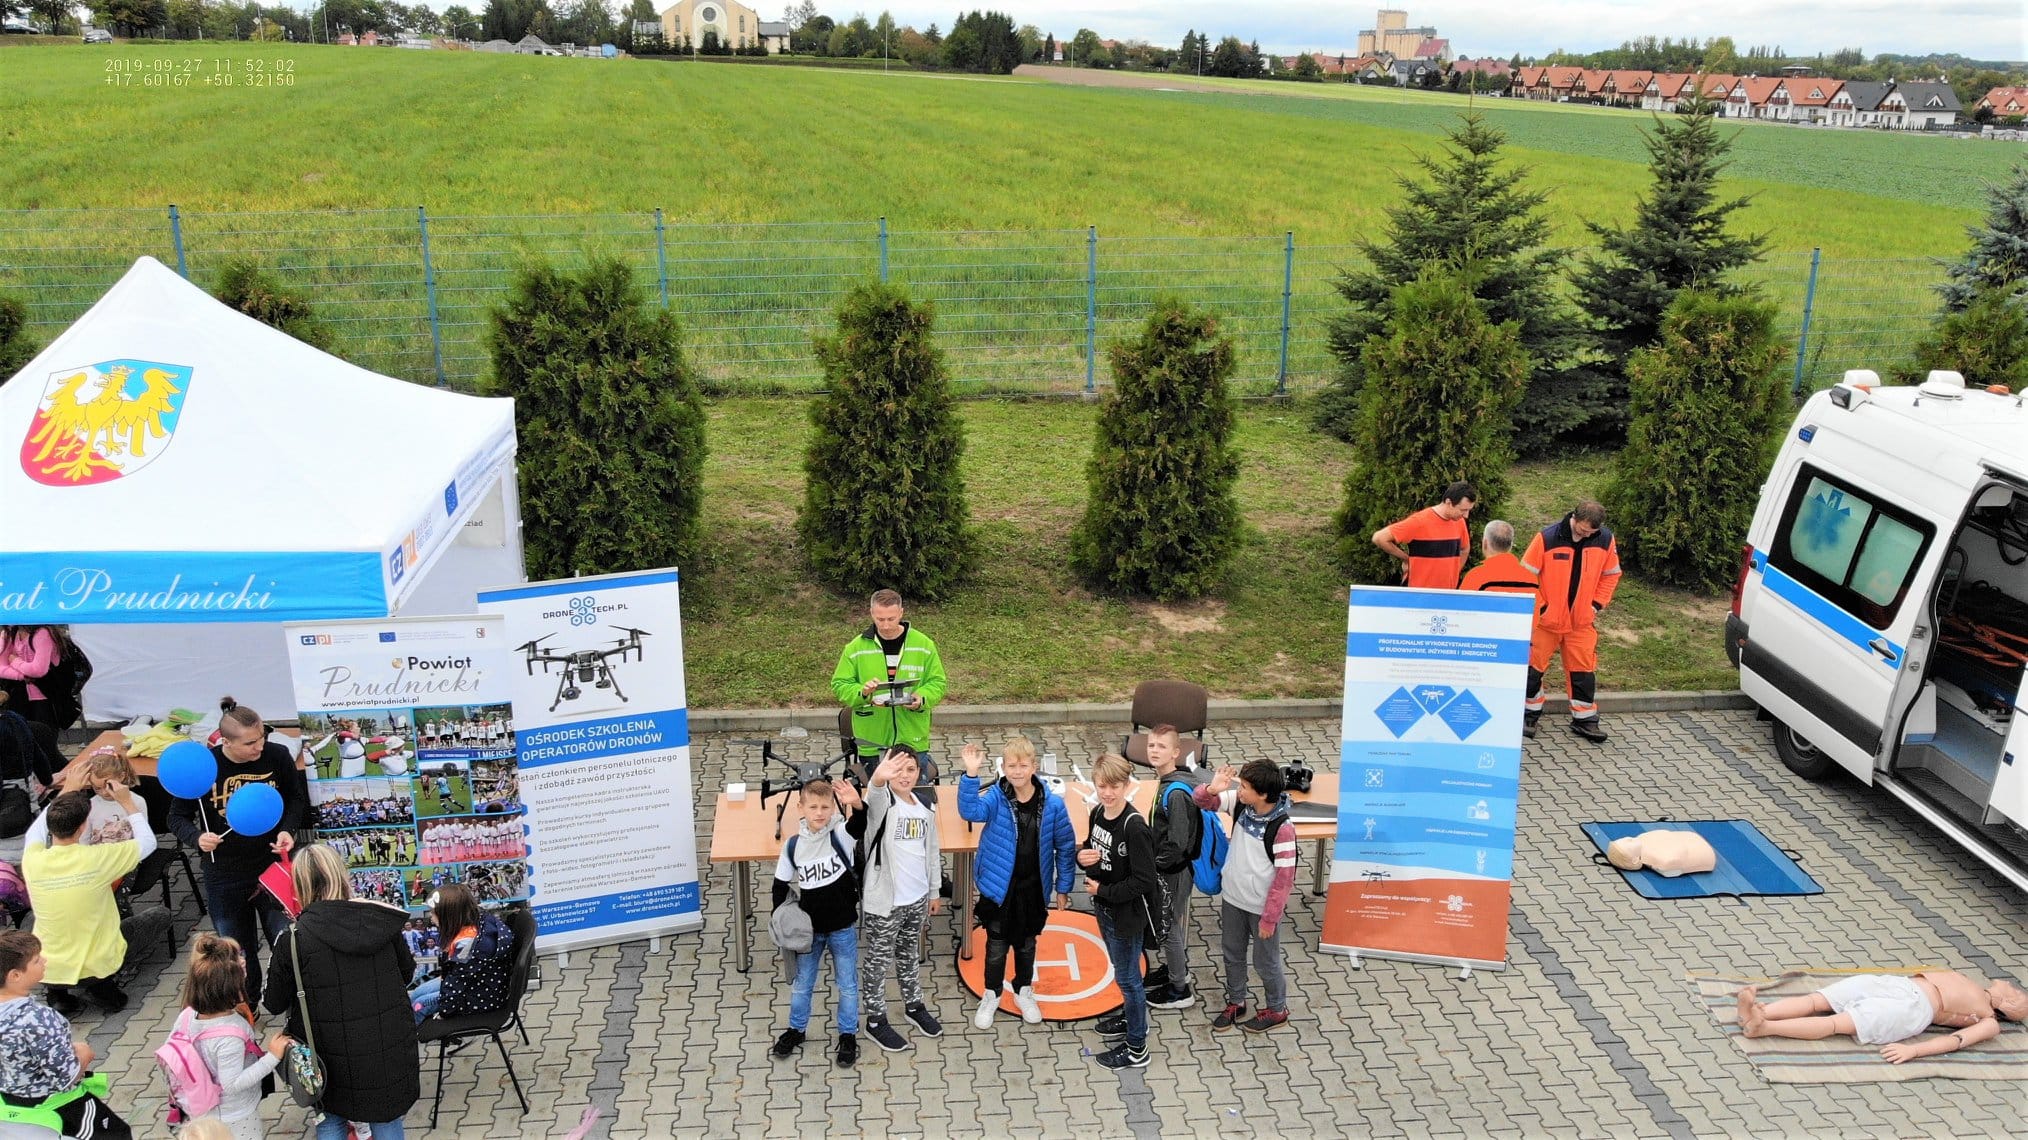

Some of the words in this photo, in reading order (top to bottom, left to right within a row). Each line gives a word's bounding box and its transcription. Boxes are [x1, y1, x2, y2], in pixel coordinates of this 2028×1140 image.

[0, 581, 49, 611] at
[54, 567, 276, 611] Prudnicki
[407, 655, 473, 671] Powiat
[319, 664, 483, 698] Prudnicki
[321, 696, 420, 708] www.powiatprudnicki.pl
[526, 727, 586, 746] OŚRODEK
[588, 719, 656, 736] SZKOLENIA
[522, 739, 607, 762] OPERATORÓW
[609, 732, 663, 750] DRONÓW
[538, 777, 576, 790] zdobądź
[576, 773, 605, 784] zawód
[606, 766, 656, 781] przyszłości
[541, 767, 586, 779] członkiem
[588, 760, 632, 773] personelu
[633, 754, 678, 766] lotniczego
[1031, 942, 1081, 981] H
